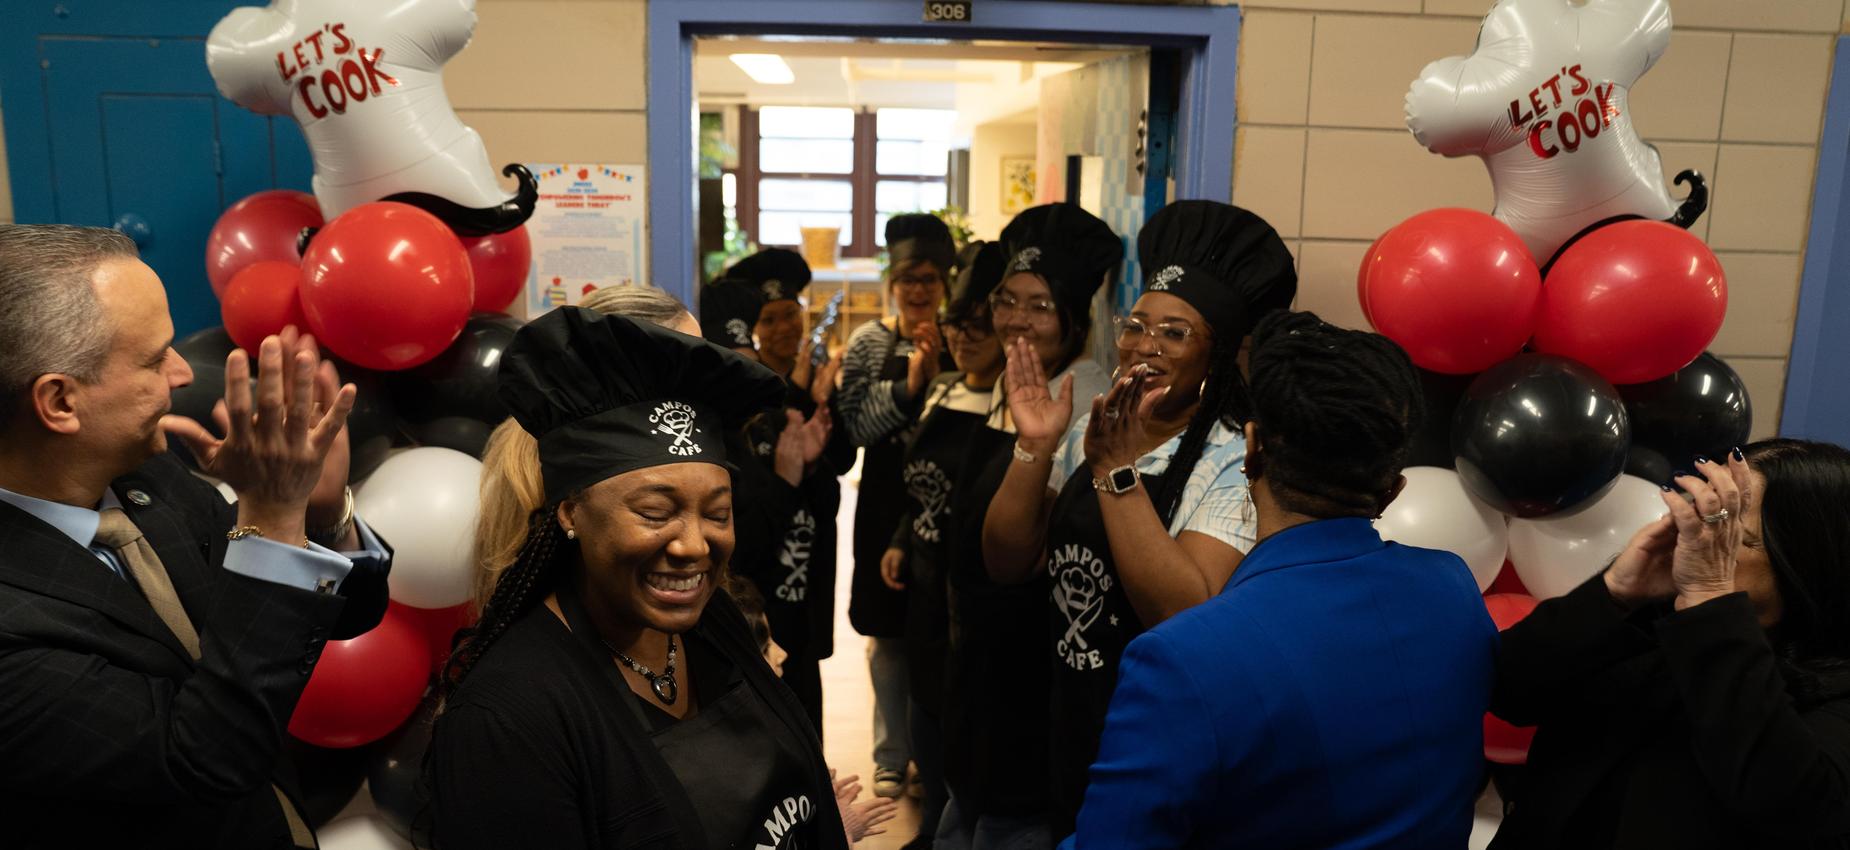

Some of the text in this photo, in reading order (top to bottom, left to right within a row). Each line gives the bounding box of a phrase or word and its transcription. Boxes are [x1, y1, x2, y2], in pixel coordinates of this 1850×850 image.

[931, 4, 965, 20] 306
[276, 22, 352, 82] LET'S
[299, 47, 400, 119] COOK
[1508, 64, 1591, 131] LET'S
[1528, 80, 1620, 159] COOK
[649, 401, 696, 423] CAMPOS
[1048, 544, 1112, 591] CAMPOS
[1057, 640, 1104, 670] CAFE
